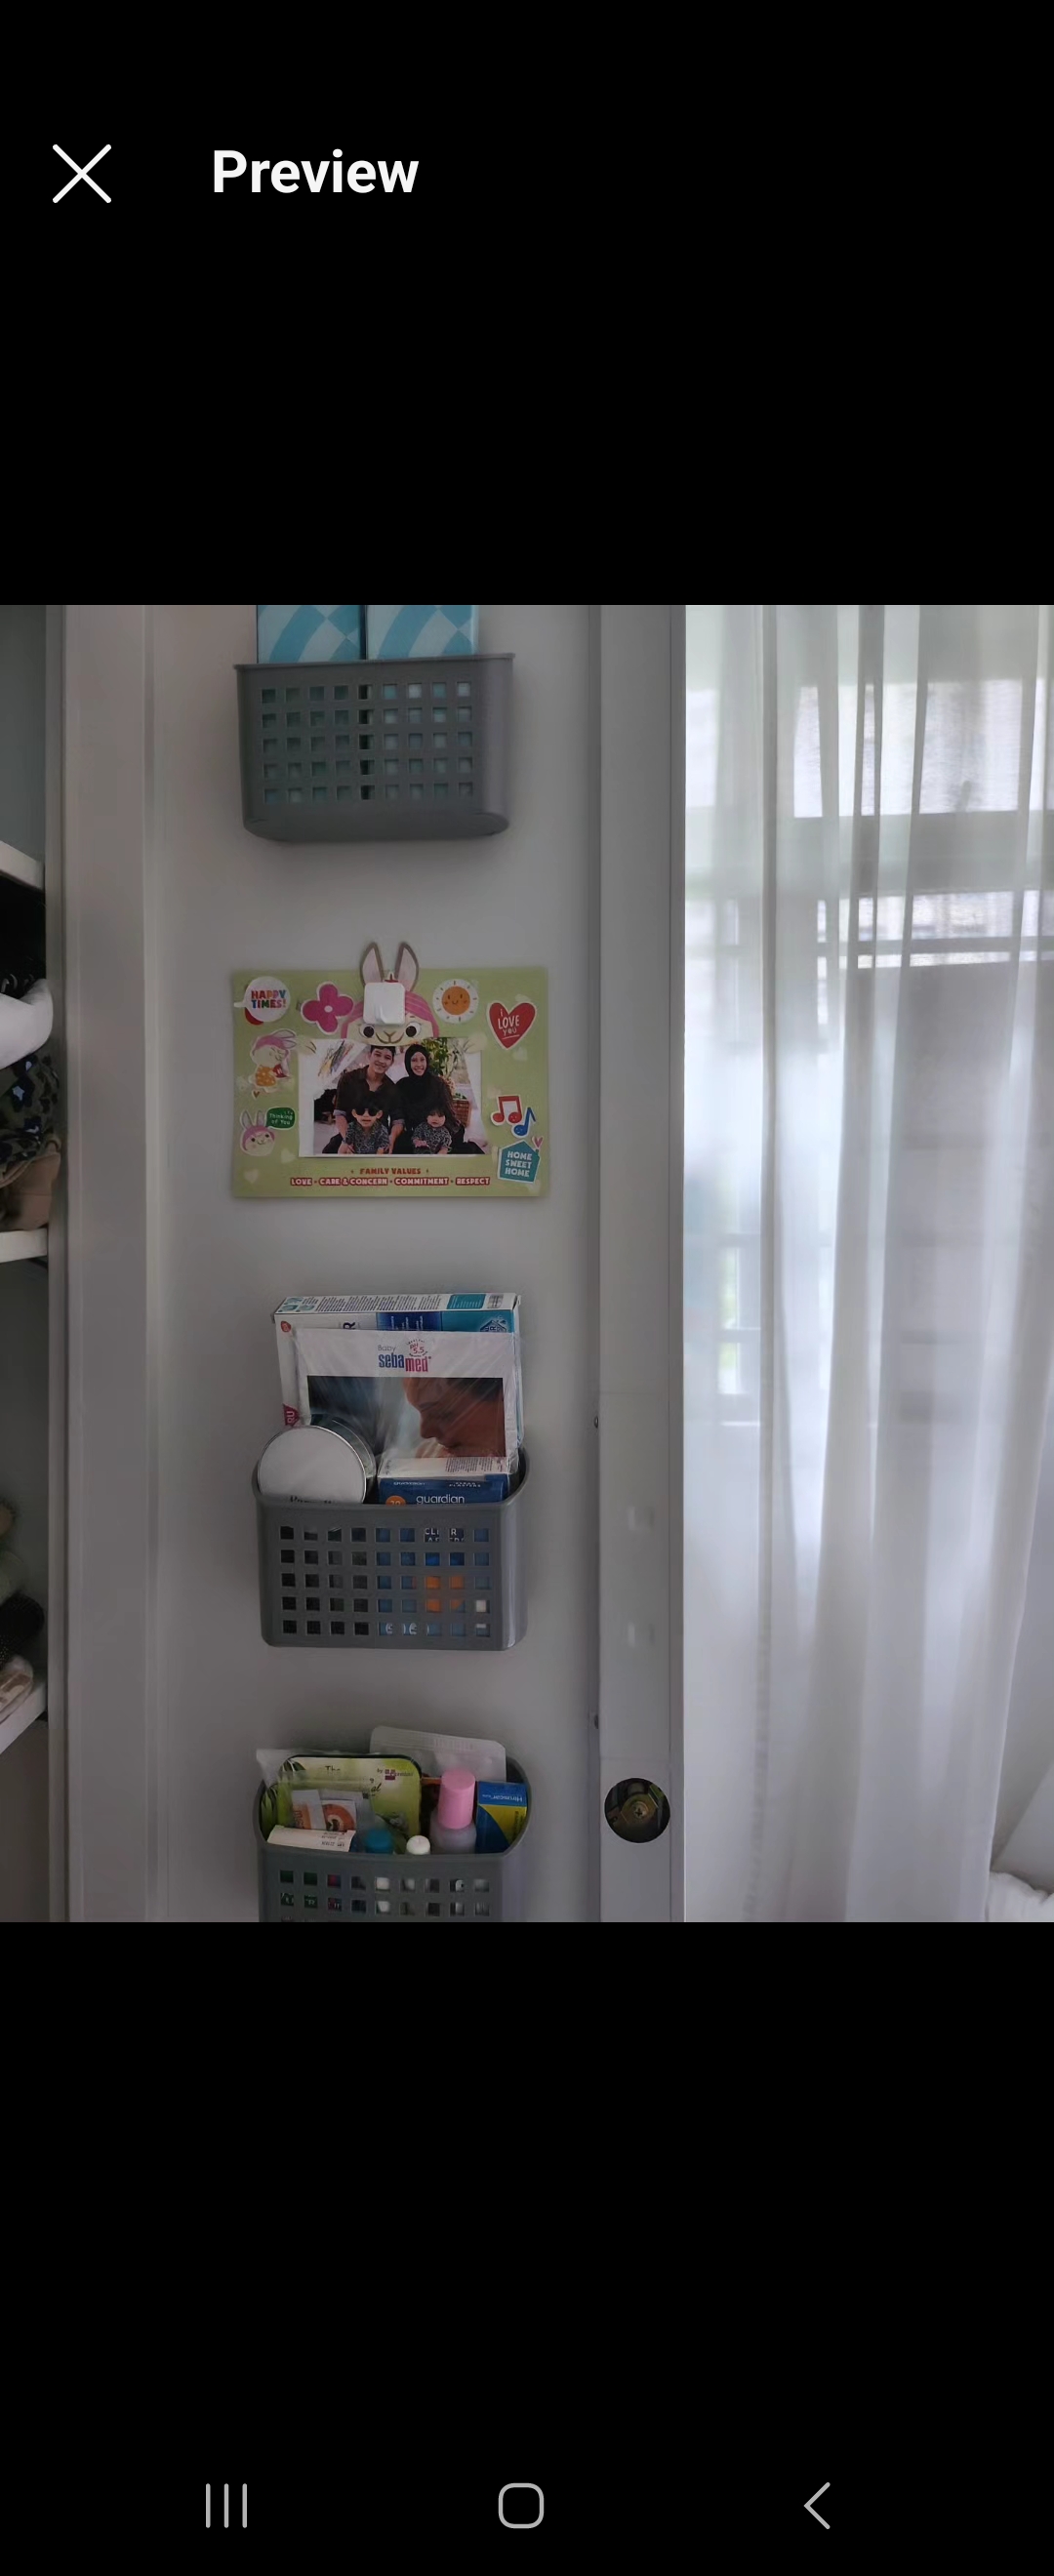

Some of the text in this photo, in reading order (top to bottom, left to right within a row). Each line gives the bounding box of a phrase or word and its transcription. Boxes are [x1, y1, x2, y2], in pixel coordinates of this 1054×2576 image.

[251, 989, 287, 999] HAPPY
[251, 999, 287, 1009] TIMES!
[498, 1015, 520, 1029] LOVE
[507, 1150, 533, 1161] HOME
[505, 1159, 533, 1169] SWEET
[505, 1167, 530, 1178] HOME
[291, 1177, 312, 1186] LOVE
[319, 1177, 341, 1186] CARE
[349, 1177, 388, 1186] CONCERN
[394, 1177, 449, 1186] COMMITMENT
[456, 1177, 490, 1186] RESPECT
[416, 1494, 466, 1504] guardian
